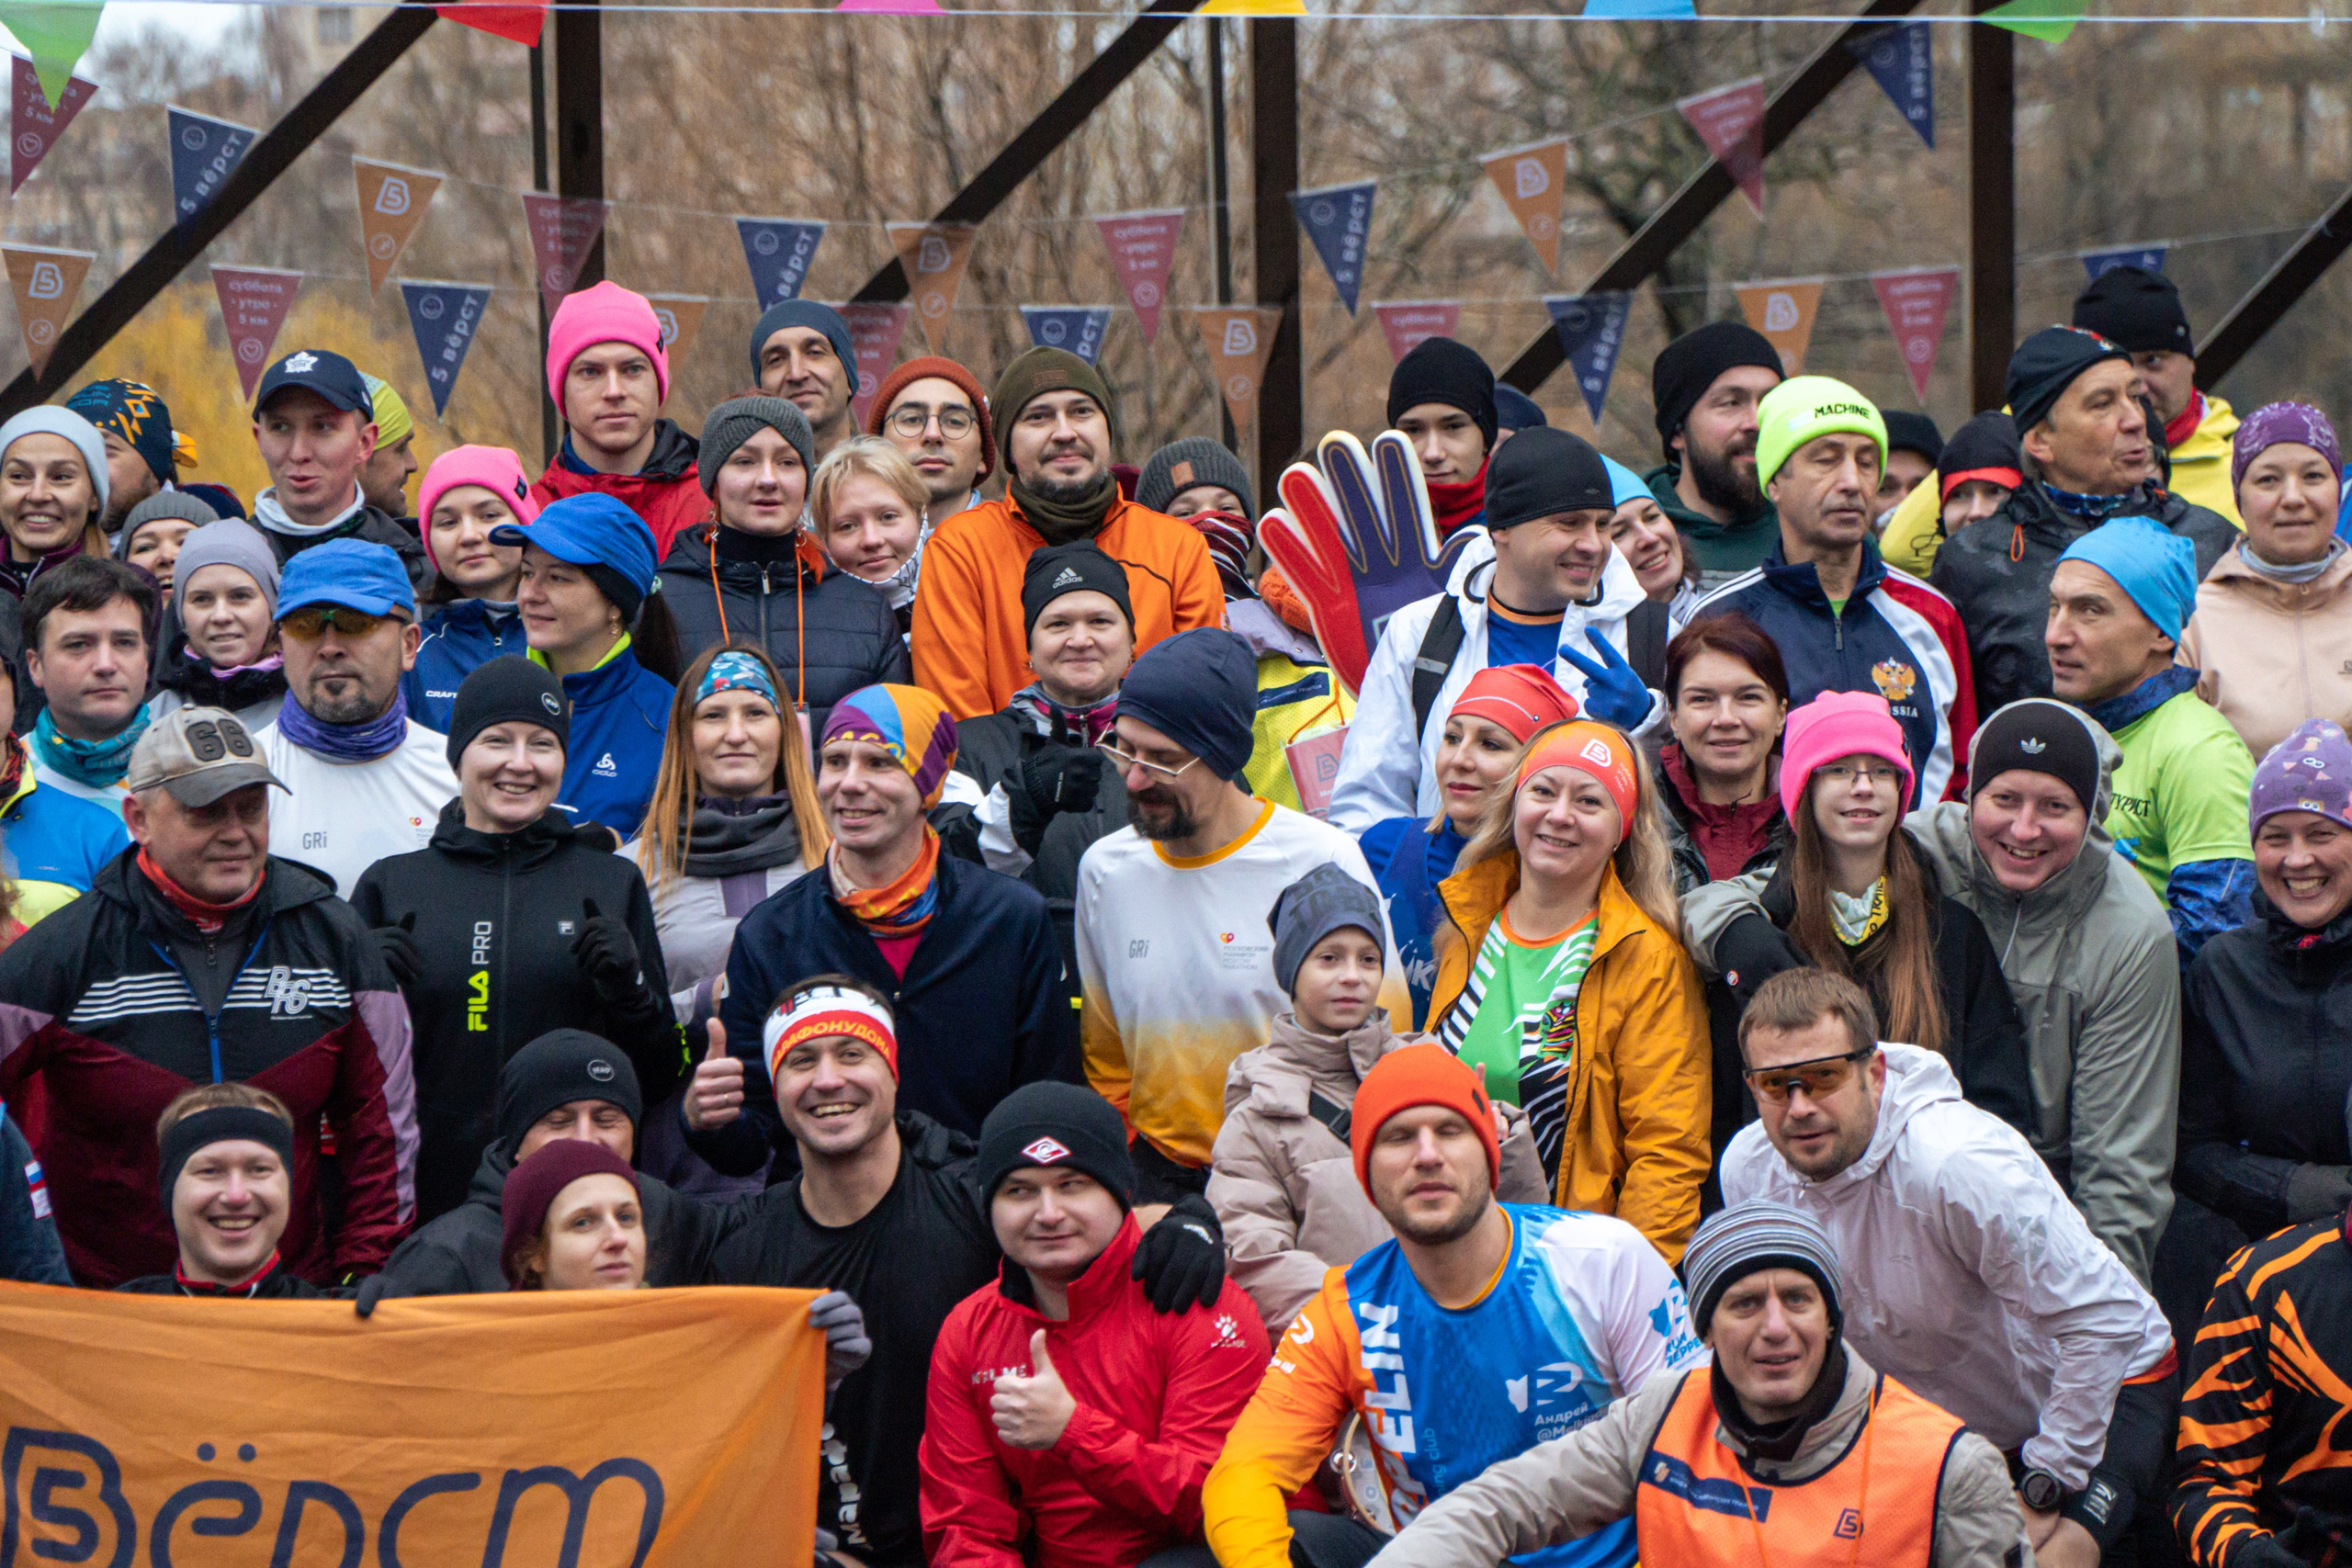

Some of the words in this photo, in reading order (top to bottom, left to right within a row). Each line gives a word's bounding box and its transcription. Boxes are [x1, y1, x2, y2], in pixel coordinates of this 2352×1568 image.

[431, 367, 449, 383] 5
[442, 293, 478, 362] вёрст
[1814, 402, 1871, 421] MACHINE
[1052, 576, 1084, 589] adidas
[425, 690, 458, 699] CRAFT
[1888, 705, 1919, 718] SSIA
[184, 717, 255, 762] 66
[302, 830, 327, 850] GRi
[471, 921, 492, 965] PRO
[1128, 939, 1149, 959] GRi
[468, 970, 490, 1032] FILA
[1534, 1402, 1589, 1427] Андрей
